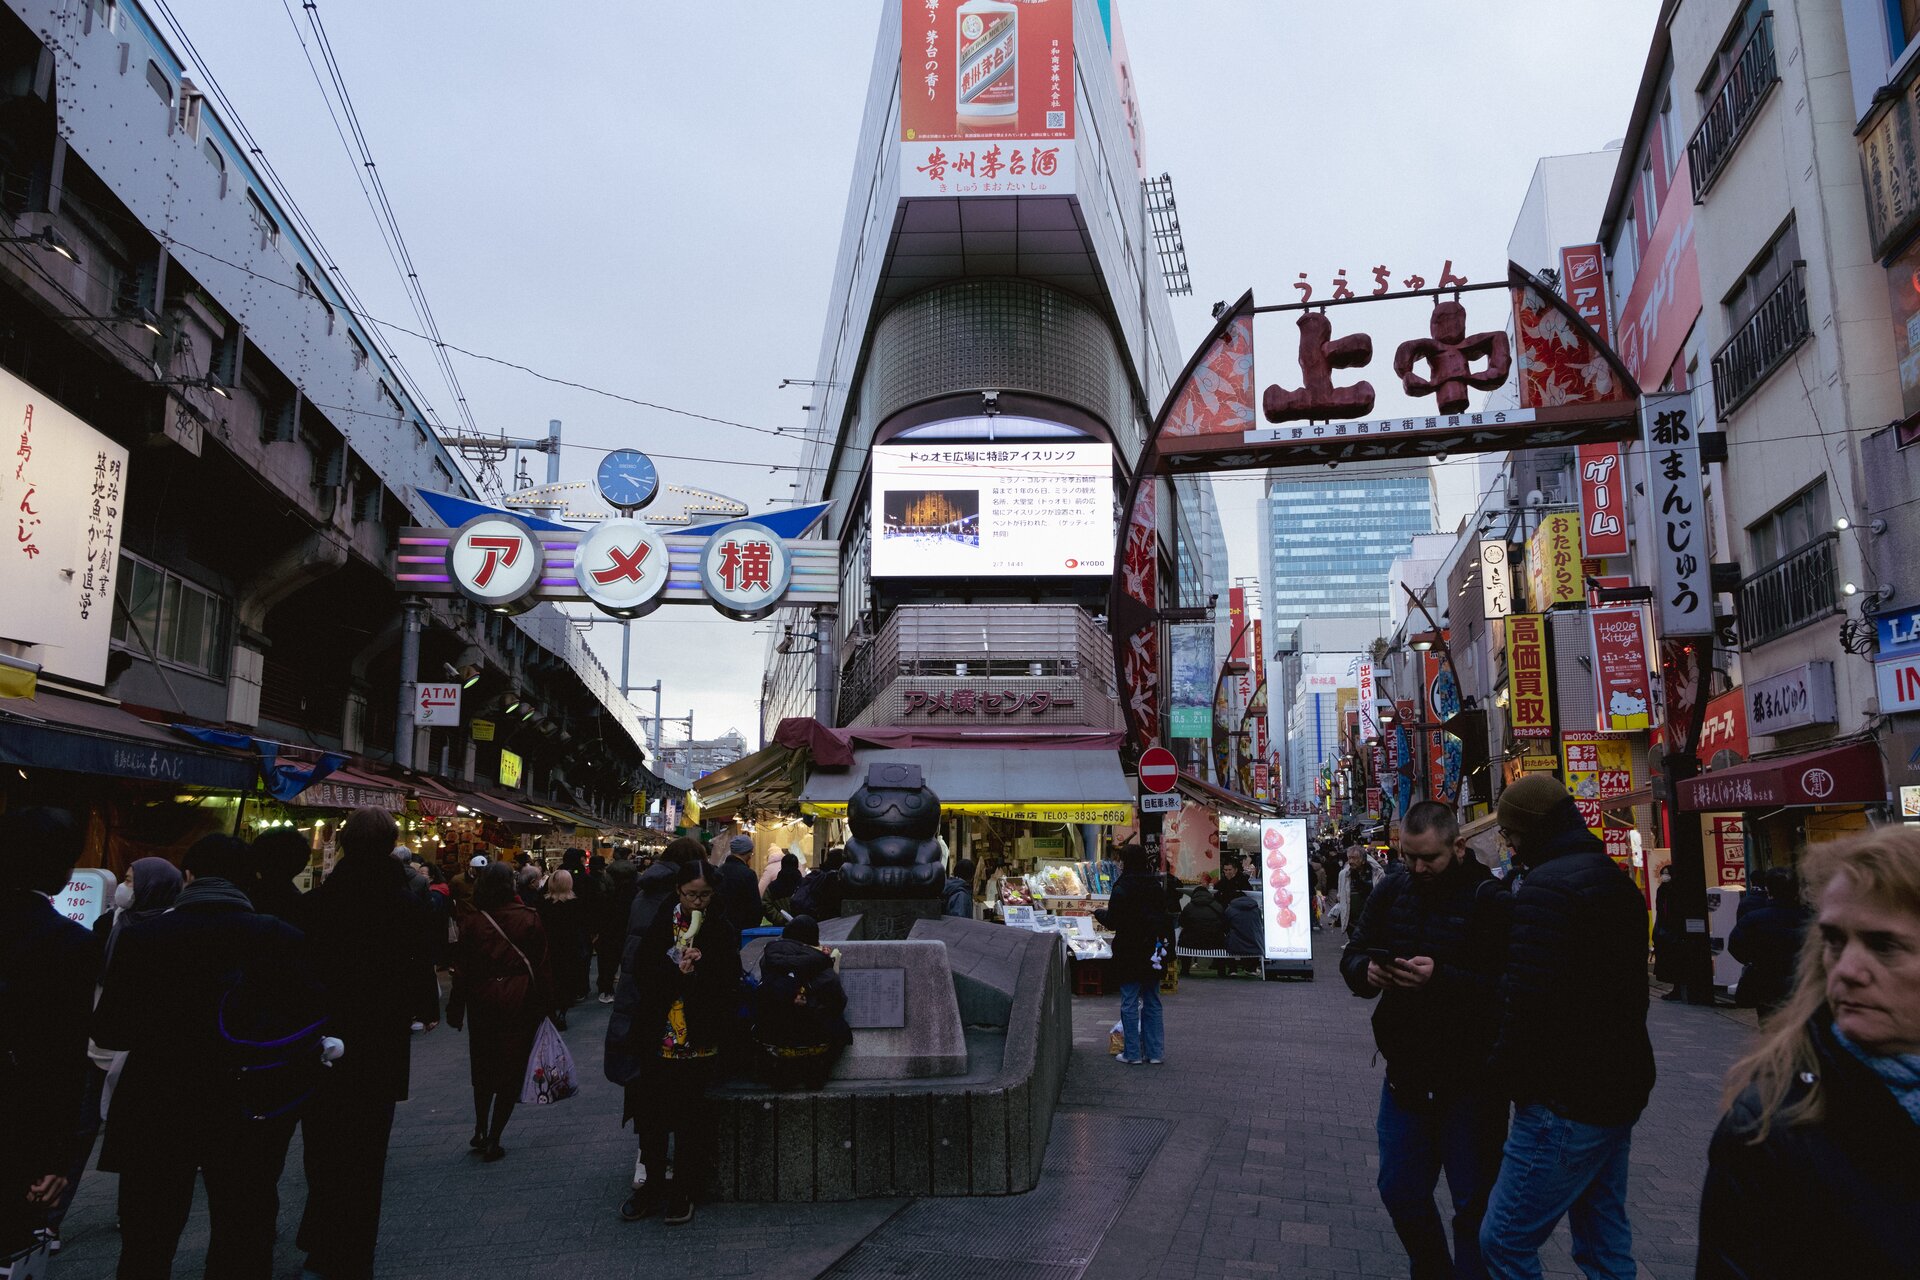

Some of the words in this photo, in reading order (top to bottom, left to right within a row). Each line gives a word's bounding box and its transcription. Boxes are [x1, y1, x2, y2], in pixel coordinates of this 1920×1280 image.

[924, 30, 939, 101] 茅台の香り
[916, 144, 1061, 182] 貴州茅台酒
[1262, 301, 1512, 424] 上中
[1269, 411, 1507, 441] 上野中通商店街振興組合
[909, 450, 1076, 463] ドゥオモ広場に特設アイスリンク
[1583, 454, 1621, 536] ゲーム
[1651, 409, 1699, 614] 都まんじゅう
[468, 535, 775, 592] アメ横
[1551, 517, 1574, 600] おたからや
[1598, 621, 1637, 633] Hello
[1601, 632, 1632, 648] Kitty
[1510, 617, 1546, 724] 高価買取
[420, 686, 457, 698] ATM
[1172, 680, 1194, 692] モネ
[903, 689, 1074, 717] アメ横センター
[1753, 681, 1807, 723] 都まんじゅう
[1513, 727, 1550, 737] おたからや
[1697, 709, 1736, 749] ドアーズ
[1567, 745, 1581, 759] 金
[1568, 760, 1598, 771] 貴金属
[1600, 772, 1629, 788] ダイヤ
[1144, 797, 1179, 809] 自転車を除く
